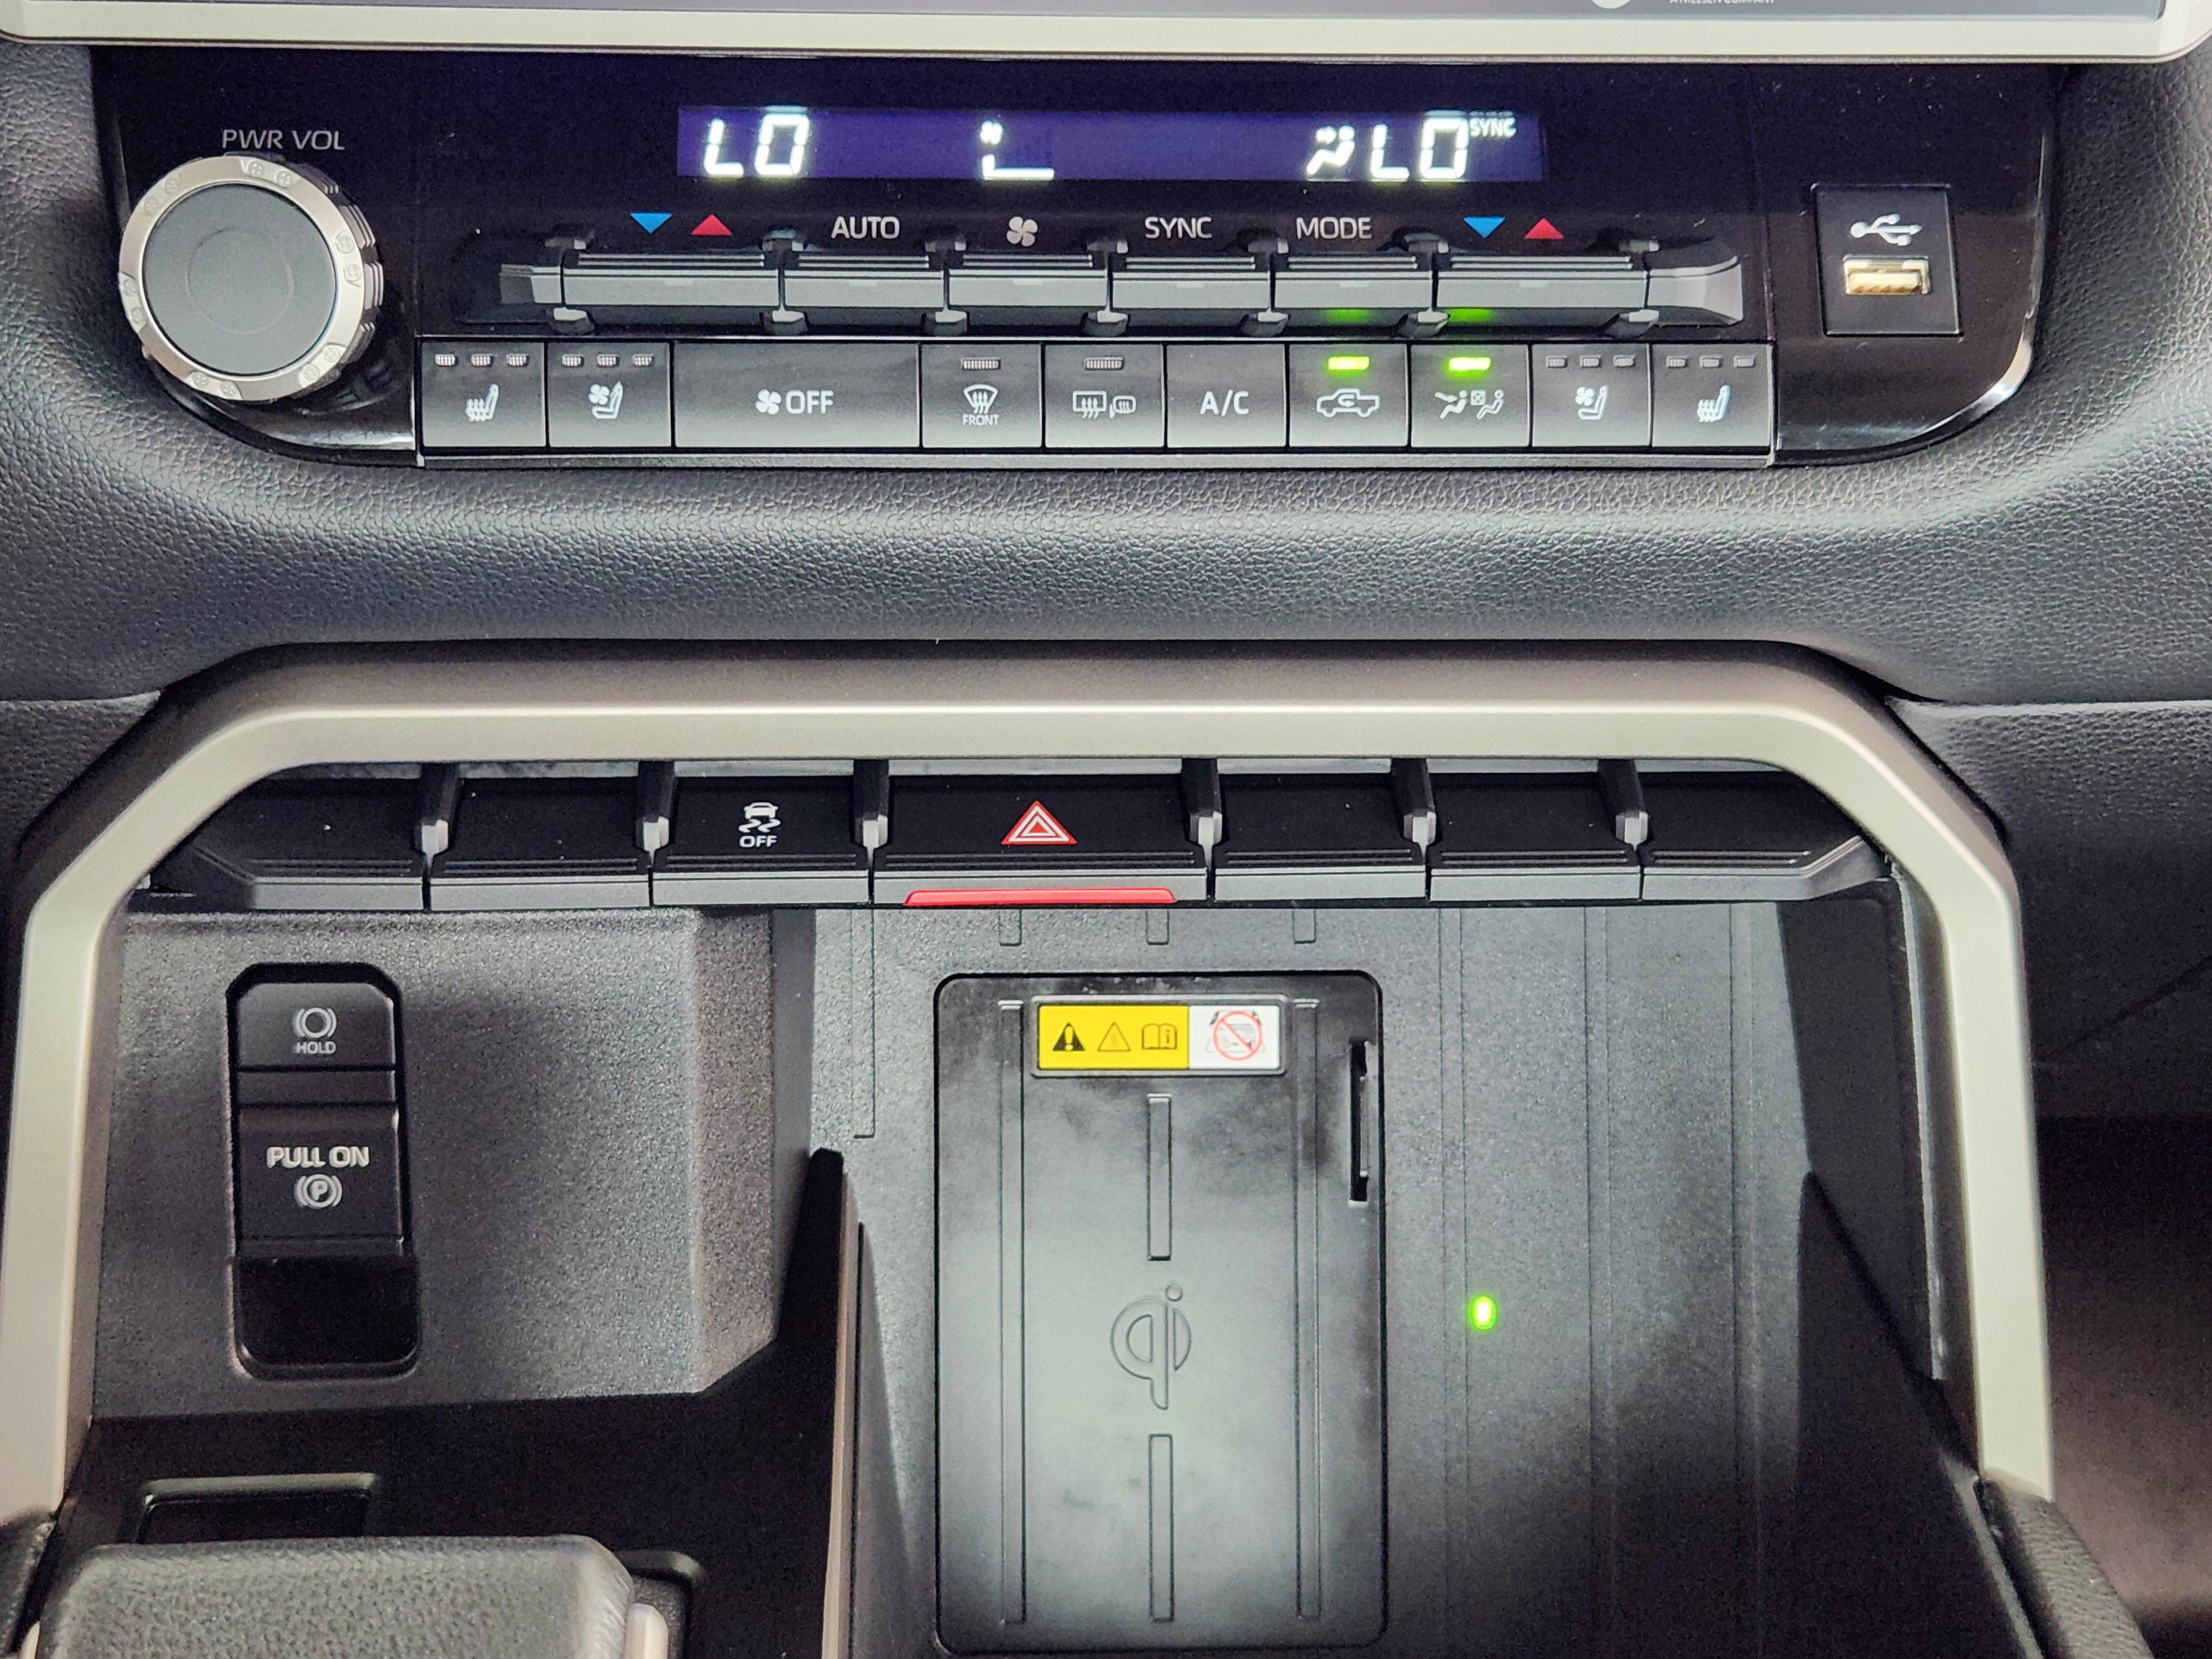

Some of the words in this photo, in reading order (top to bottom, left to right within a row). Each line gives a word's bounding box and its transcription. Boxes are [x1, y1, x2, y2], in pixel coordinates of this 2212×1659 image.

[1469, 117, 1517, 138] SYNC
[222, 129, 283, 149] PWR
[292, 130, 346, 150] VOL
[703, 114, 810, 177] LO
[1370, 117, 1469, 180] LO
[831, 216, 900, 239] AUTO
[1145, 216, 1213, 239] SYNC
[1296, 216, 1372, 240] MODE
[785, 389, 834, 414] OFF
[1199, 390, 1249, 417] A/C
[963, 414, 1000, 427] FRONT
[739, 834, 778, 848] OFF
[294, 1041, 336, 1055] HOLD
[267, 1146, 326, 1168] PULL
[330, 1146, 369, 1167] ON
